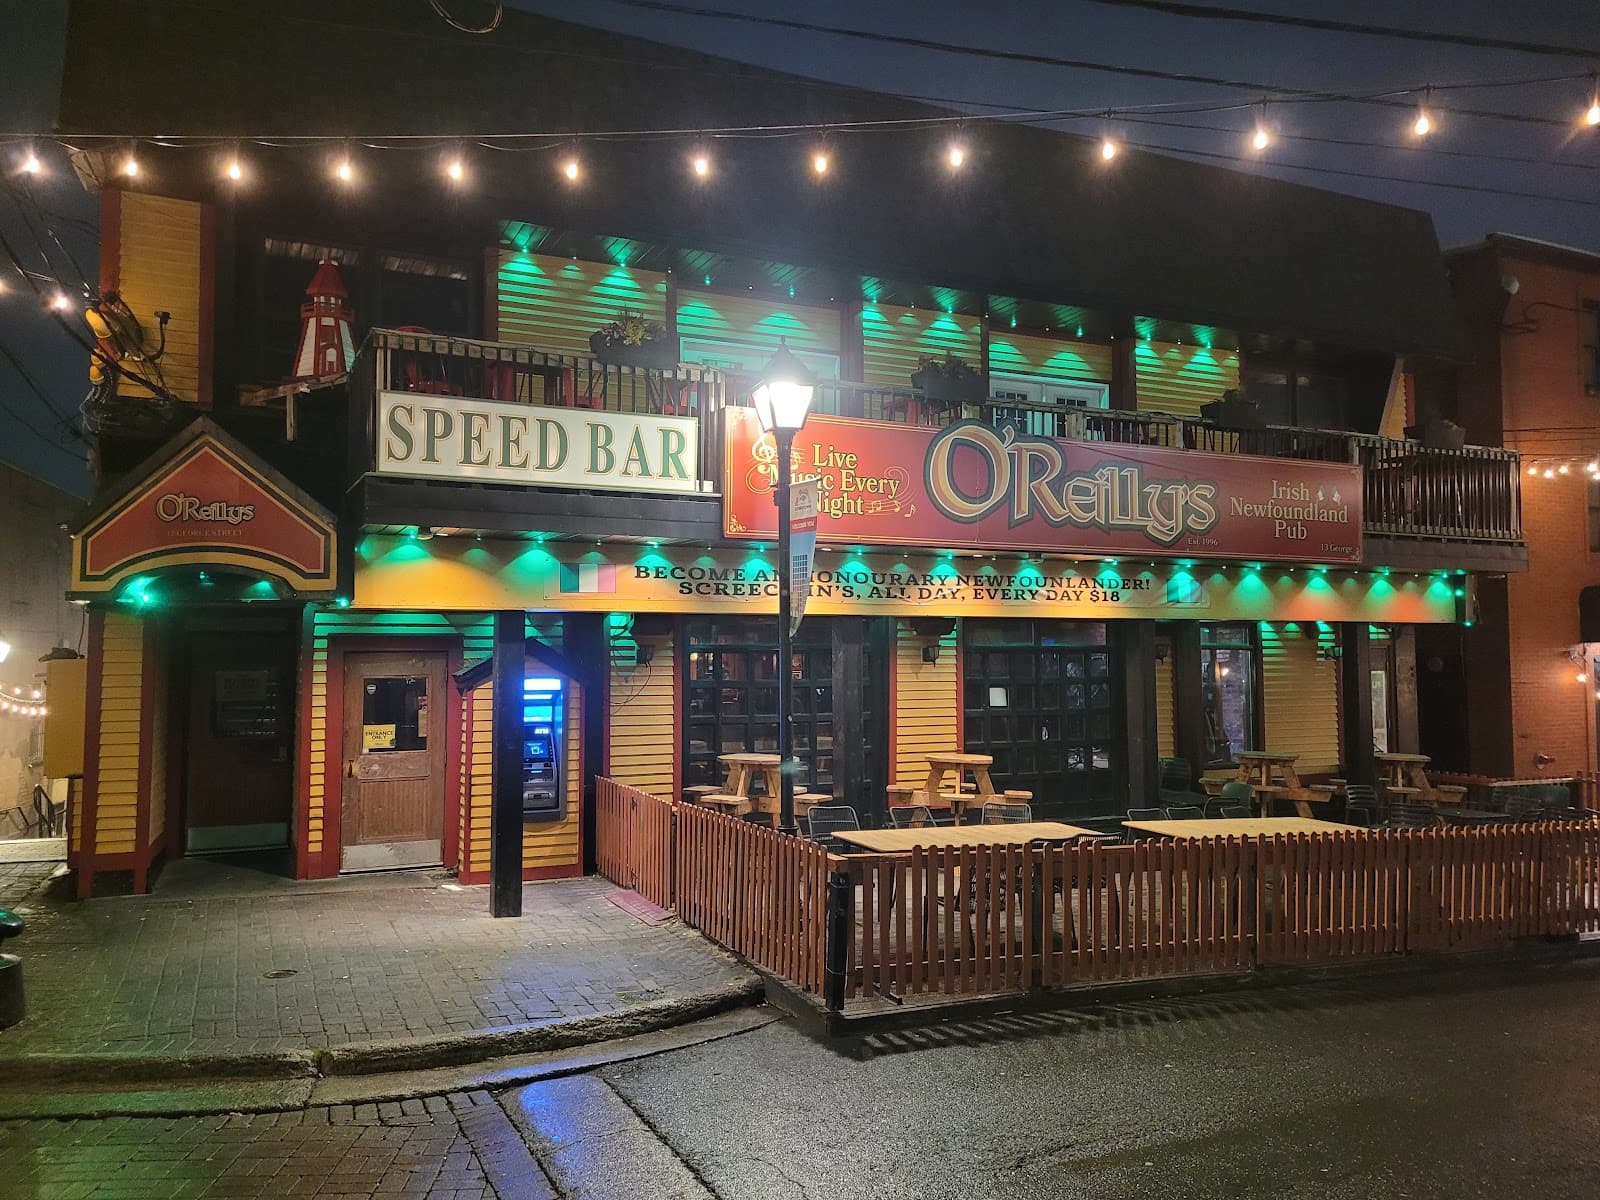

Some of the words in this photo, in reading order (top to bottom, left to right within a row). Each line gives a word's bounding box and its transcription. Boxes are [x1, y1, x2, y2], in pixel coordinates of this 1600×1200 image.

[386, 402, 569, 473] SPEED
[584, 421, 690, 480] BAR
[812, 443, 857, 469] Live
[840, 469, 900, 499] Every
[1271, 479, 1310, 501] Irish
[1230, 496, 1348, 523] Newfoundland
[1274, 519, 1308, 540] Pub
[634, 565, 746, 582] BECOME
[956, 575, 1151, 590] NEWFOUNLANDER!
[679, 581, 779, 596] SCREEC
[867, 586, 911, 599] ALL
[918, 587, 965, 601] DAY,
[973, 588, 1040, 600] EVERY
[1046, 589, 1083, 601] DAY
[1090, 590, 1120, 602] $18
